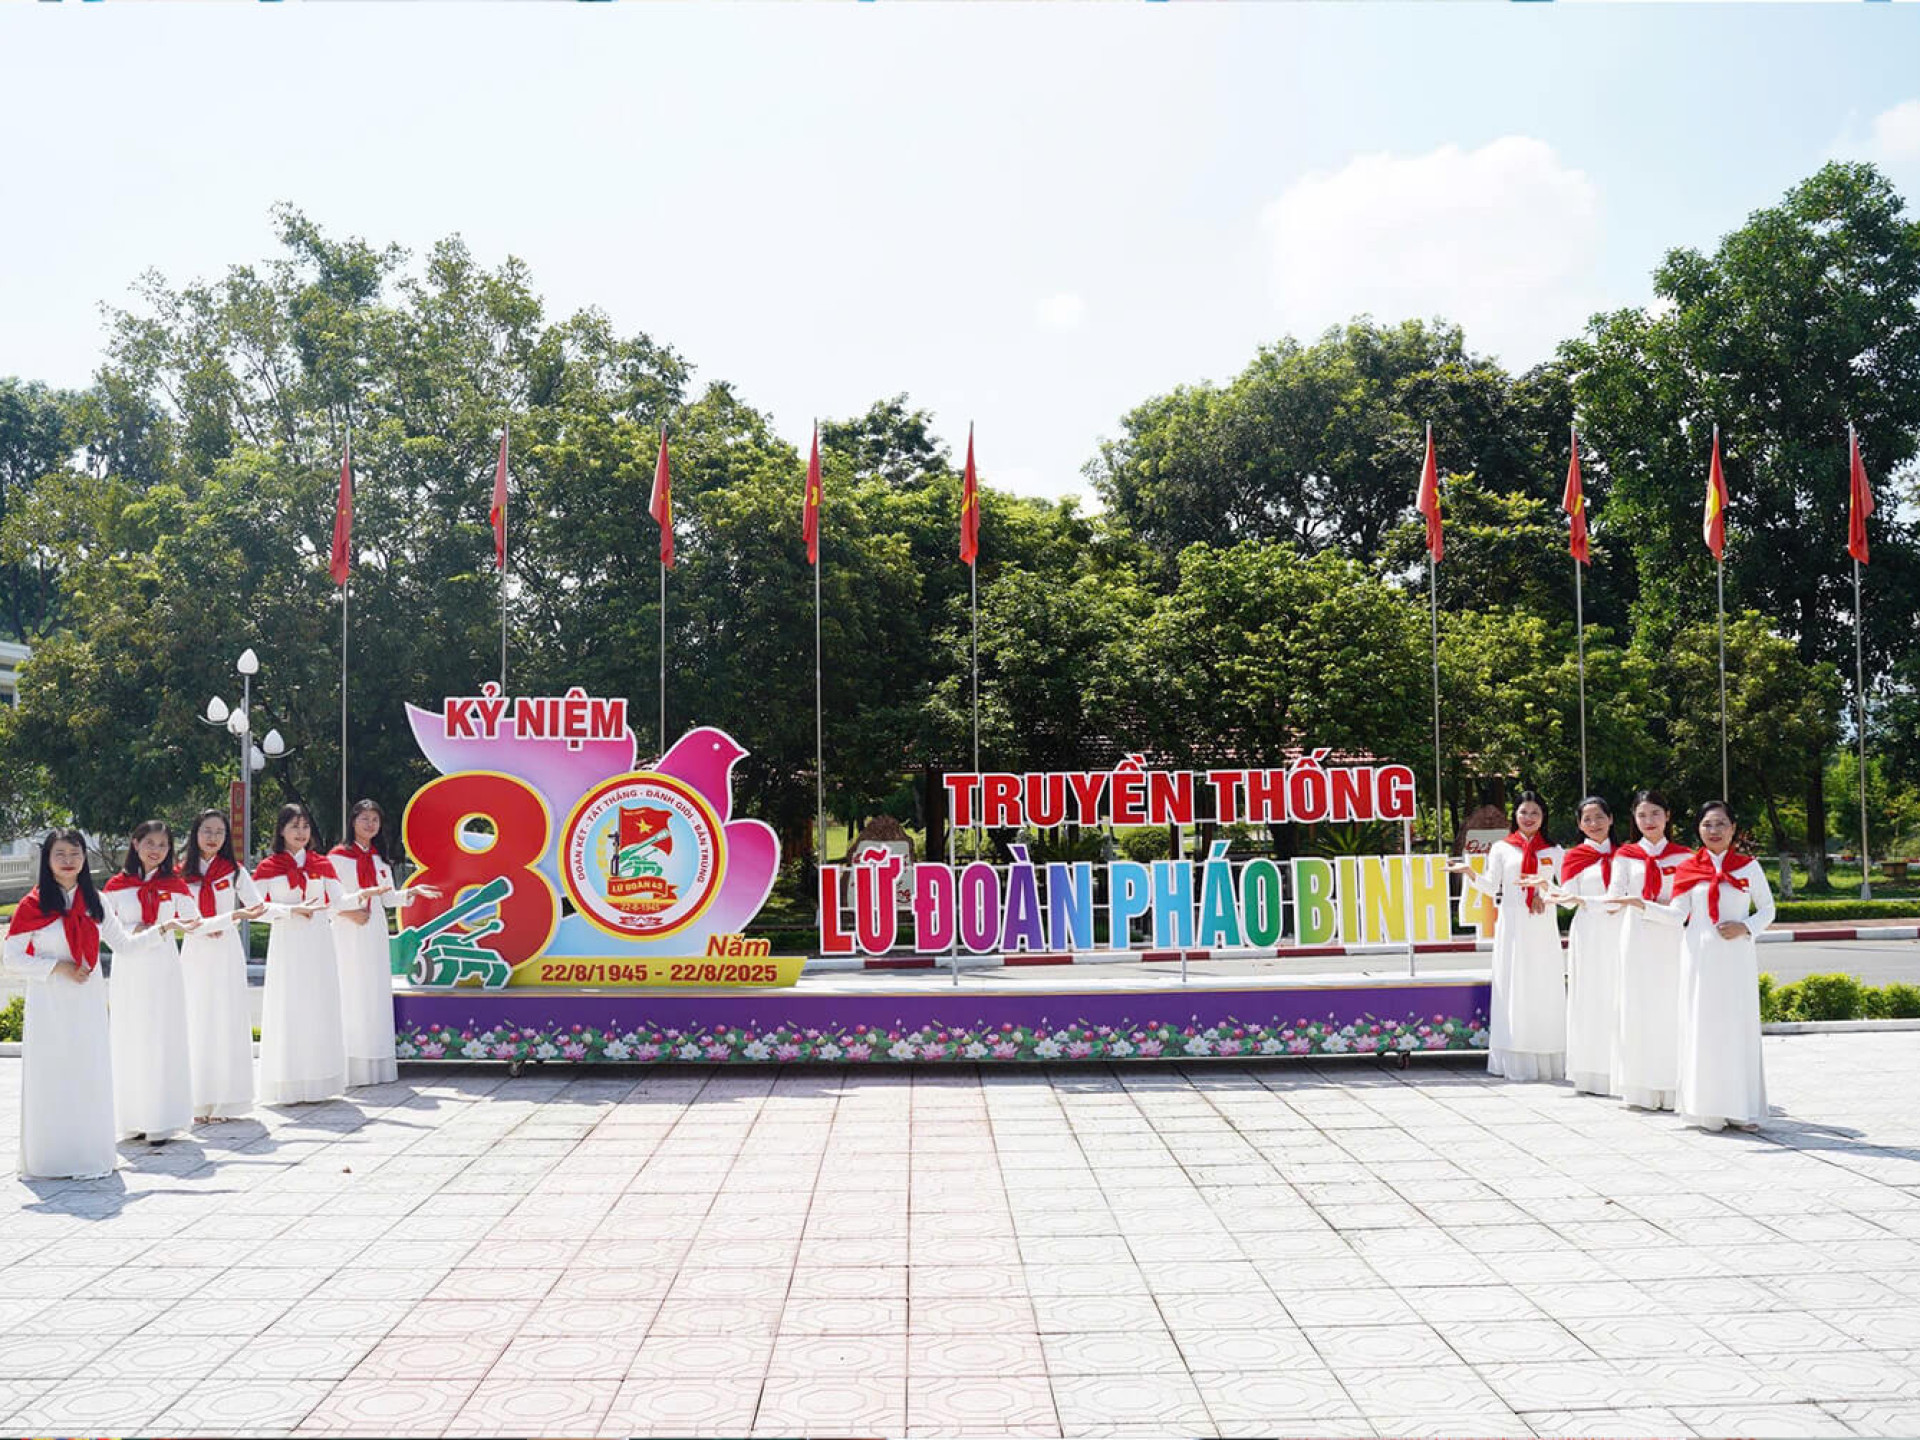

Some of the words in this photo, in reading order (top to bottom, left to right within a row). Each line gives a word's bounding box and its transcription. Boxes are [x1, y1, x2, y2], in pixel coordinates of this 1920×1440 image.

[446, 682, 507, 739] KỶ
[515, 687, 626, 750] NIỆM
[944, 754, 1194, 827] TRUYỀN
[1207, 748, 1416, 824] THỐNG
[821, 846, 901, 955] LỮ
[914, 844, 1094, 954] ĐOÀN
[1109, 840, 1281, 949] PHÁO
[1291, 854, 1451, 946] BINH
[541, 964, 647, 982] 22/8/1945
[670, 964, 778, 982] 22/8/2025
[708, 933, 770, 957] Năm
